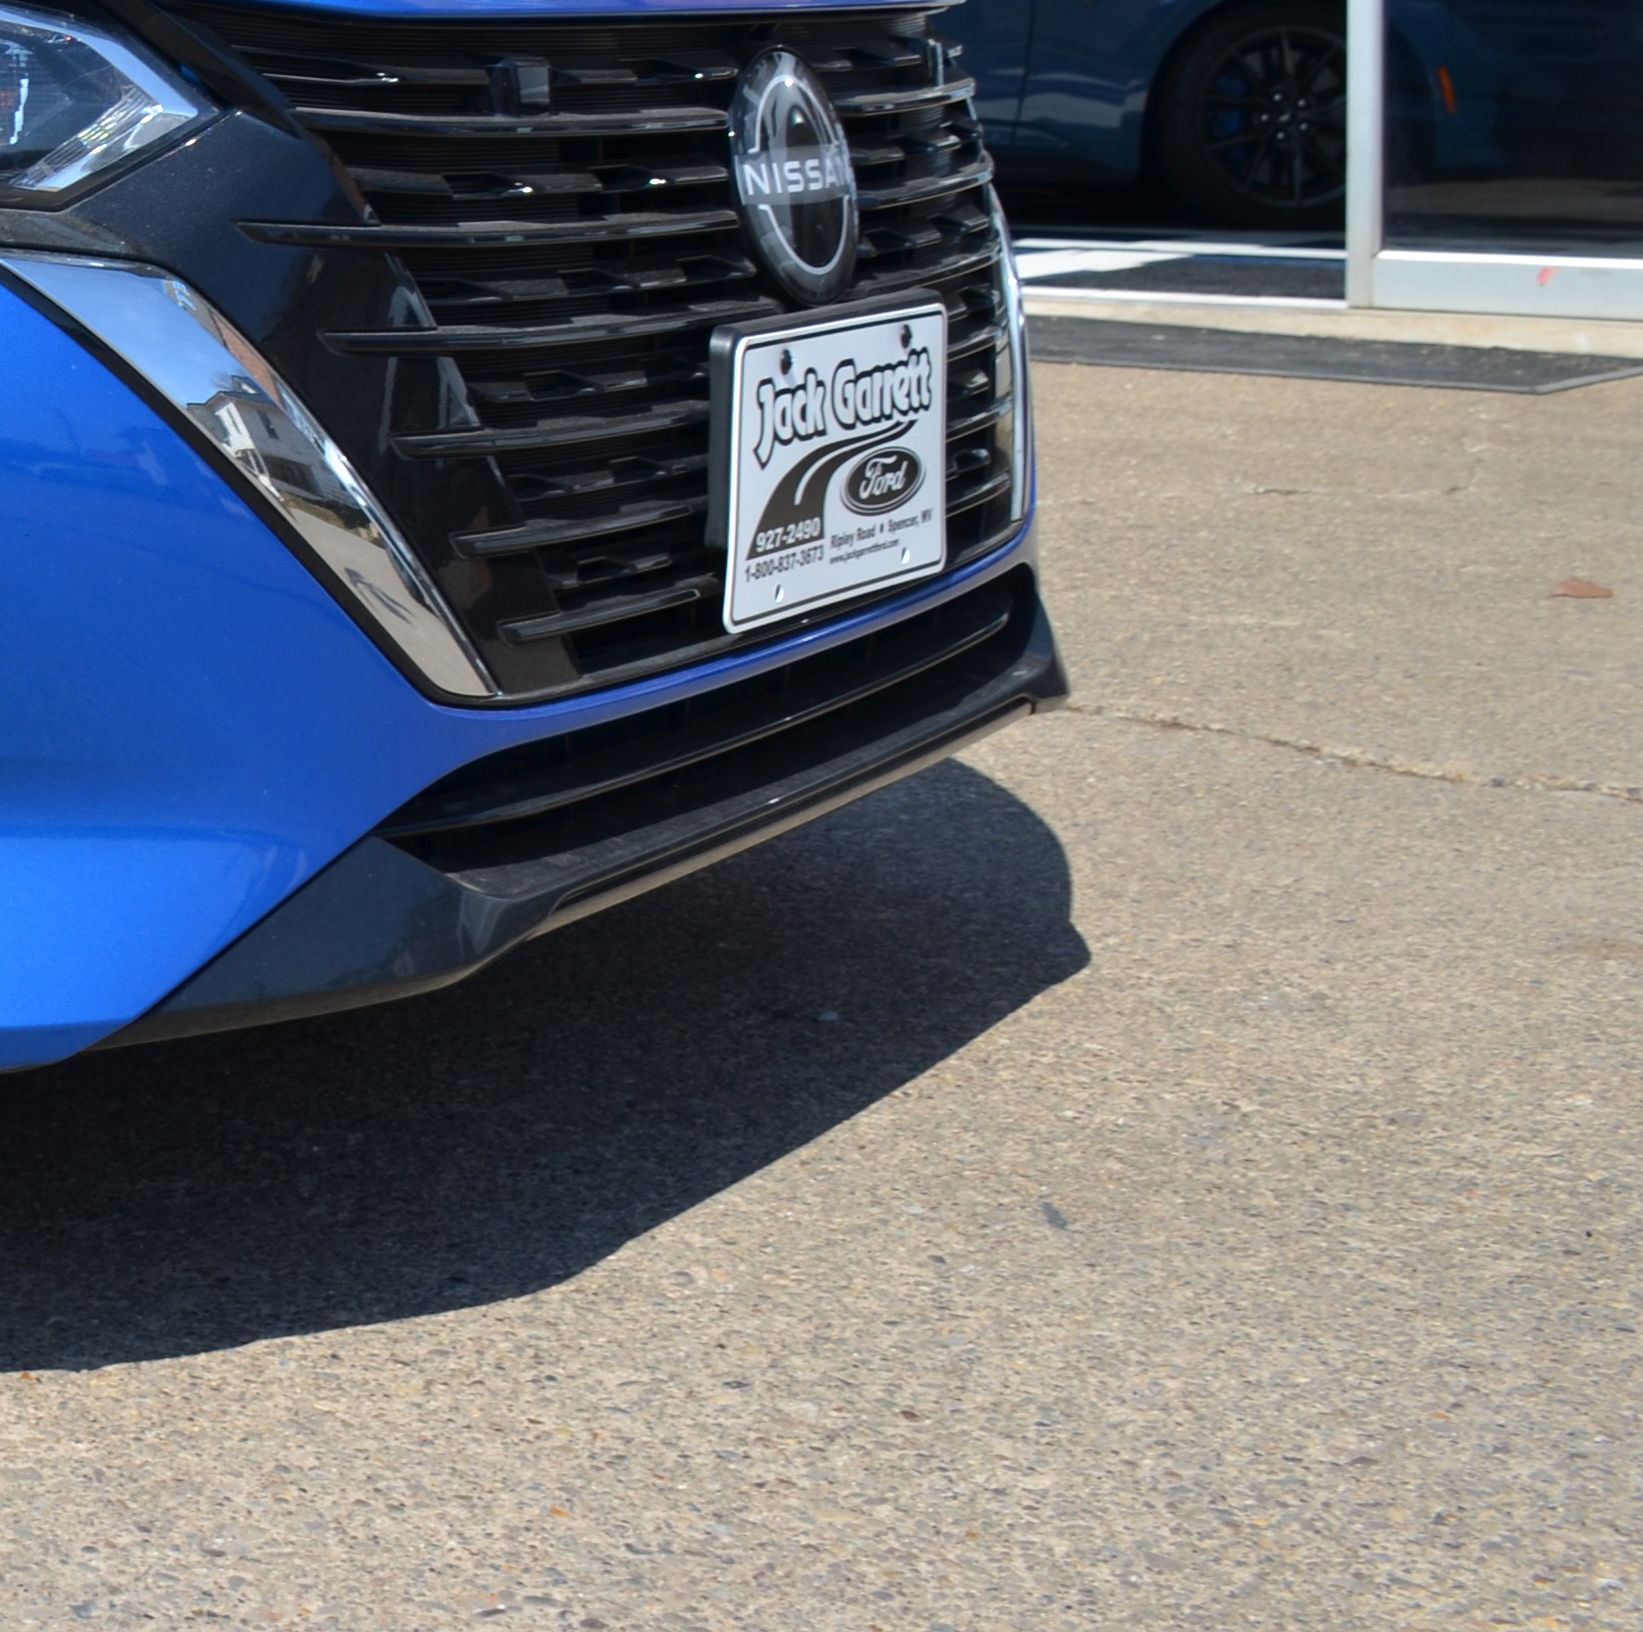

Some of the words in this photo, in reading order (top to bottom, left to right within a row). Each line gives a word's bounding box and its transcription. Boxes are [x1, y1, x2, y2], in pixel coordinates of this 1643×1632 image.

[742, 155, 849, 196] NISSAN
[753, 366, 827, 470] Jack
[831, 347, 933, 428] Garrett
[859, 455, 908, 500] Ford
[755, 517, 821, 553] 927-2490
[830, 532, 854, 550] Ripley
[856, 524, 877, 542] Road
